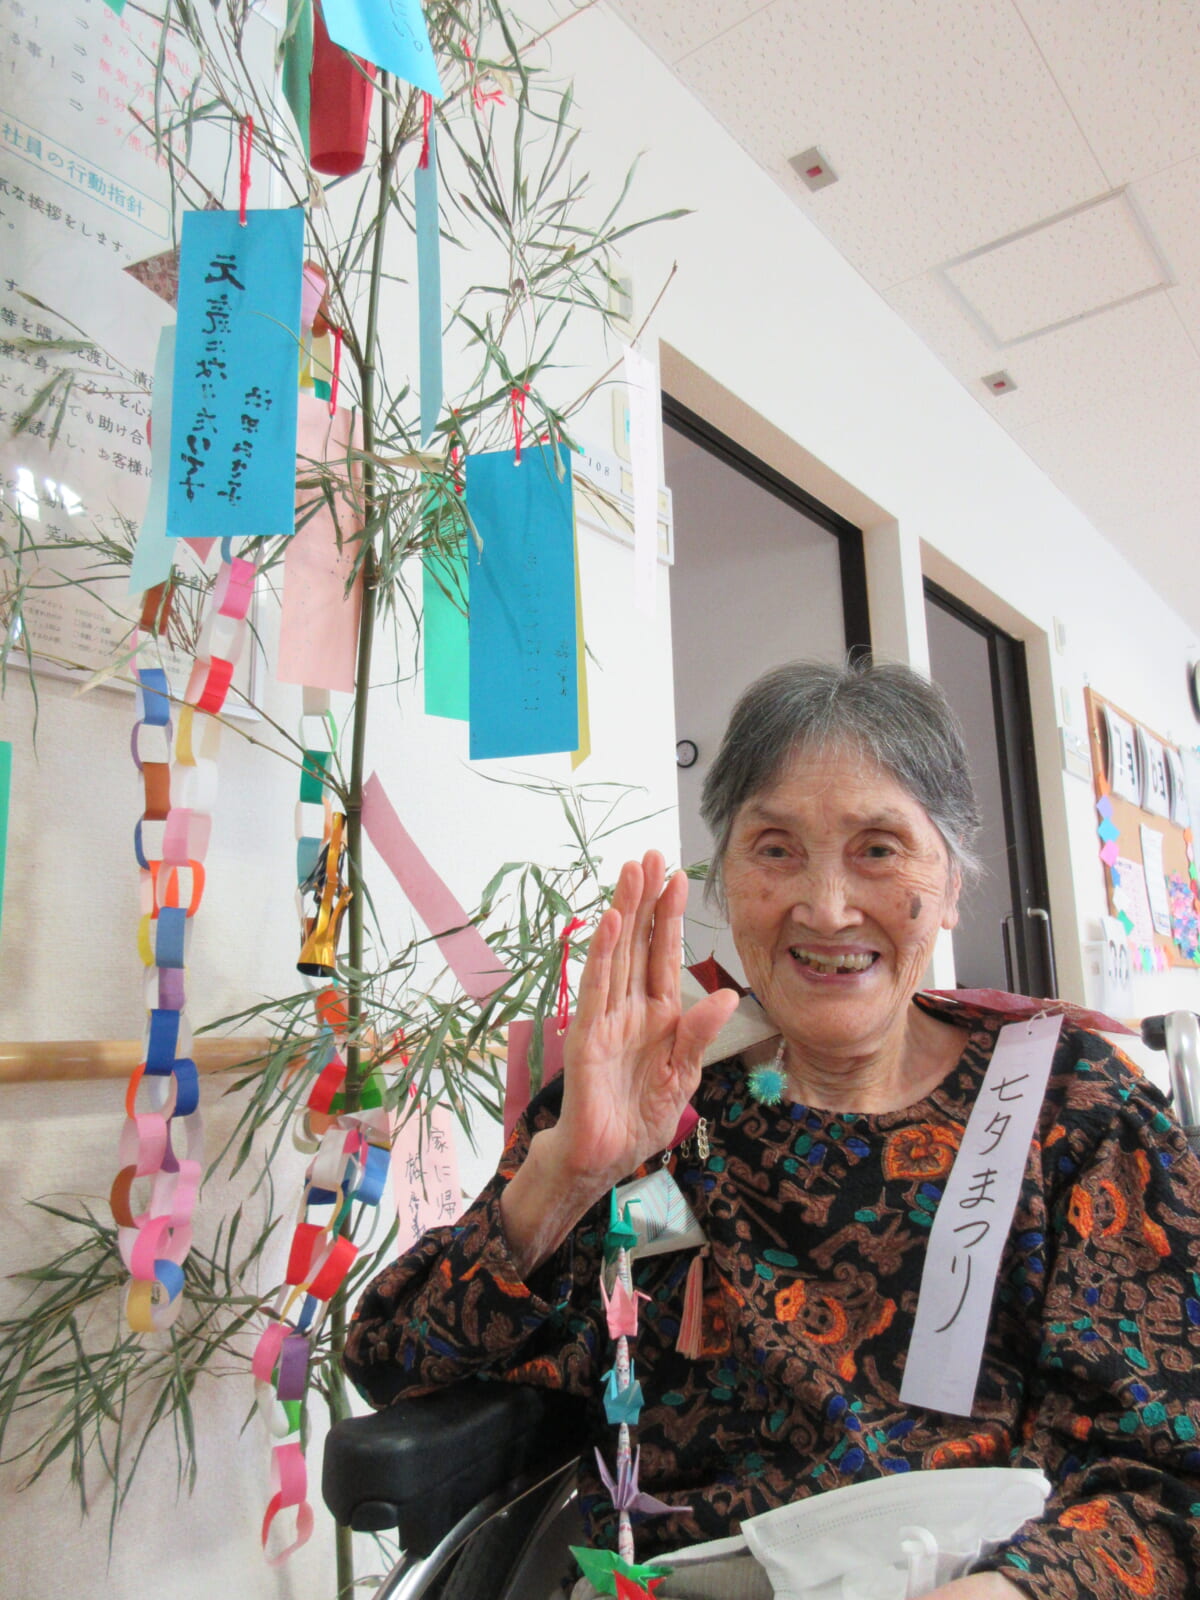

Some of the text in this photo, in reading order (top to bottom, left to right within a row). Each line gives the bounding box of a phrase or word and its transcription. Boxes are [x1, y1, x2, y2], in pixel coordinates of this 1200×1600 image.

[1, 122, 146, 220] 社員の行動指針
[587, 457, 610, 477] 108
[934, 1073, 1030, 1333] 七夕まつり
